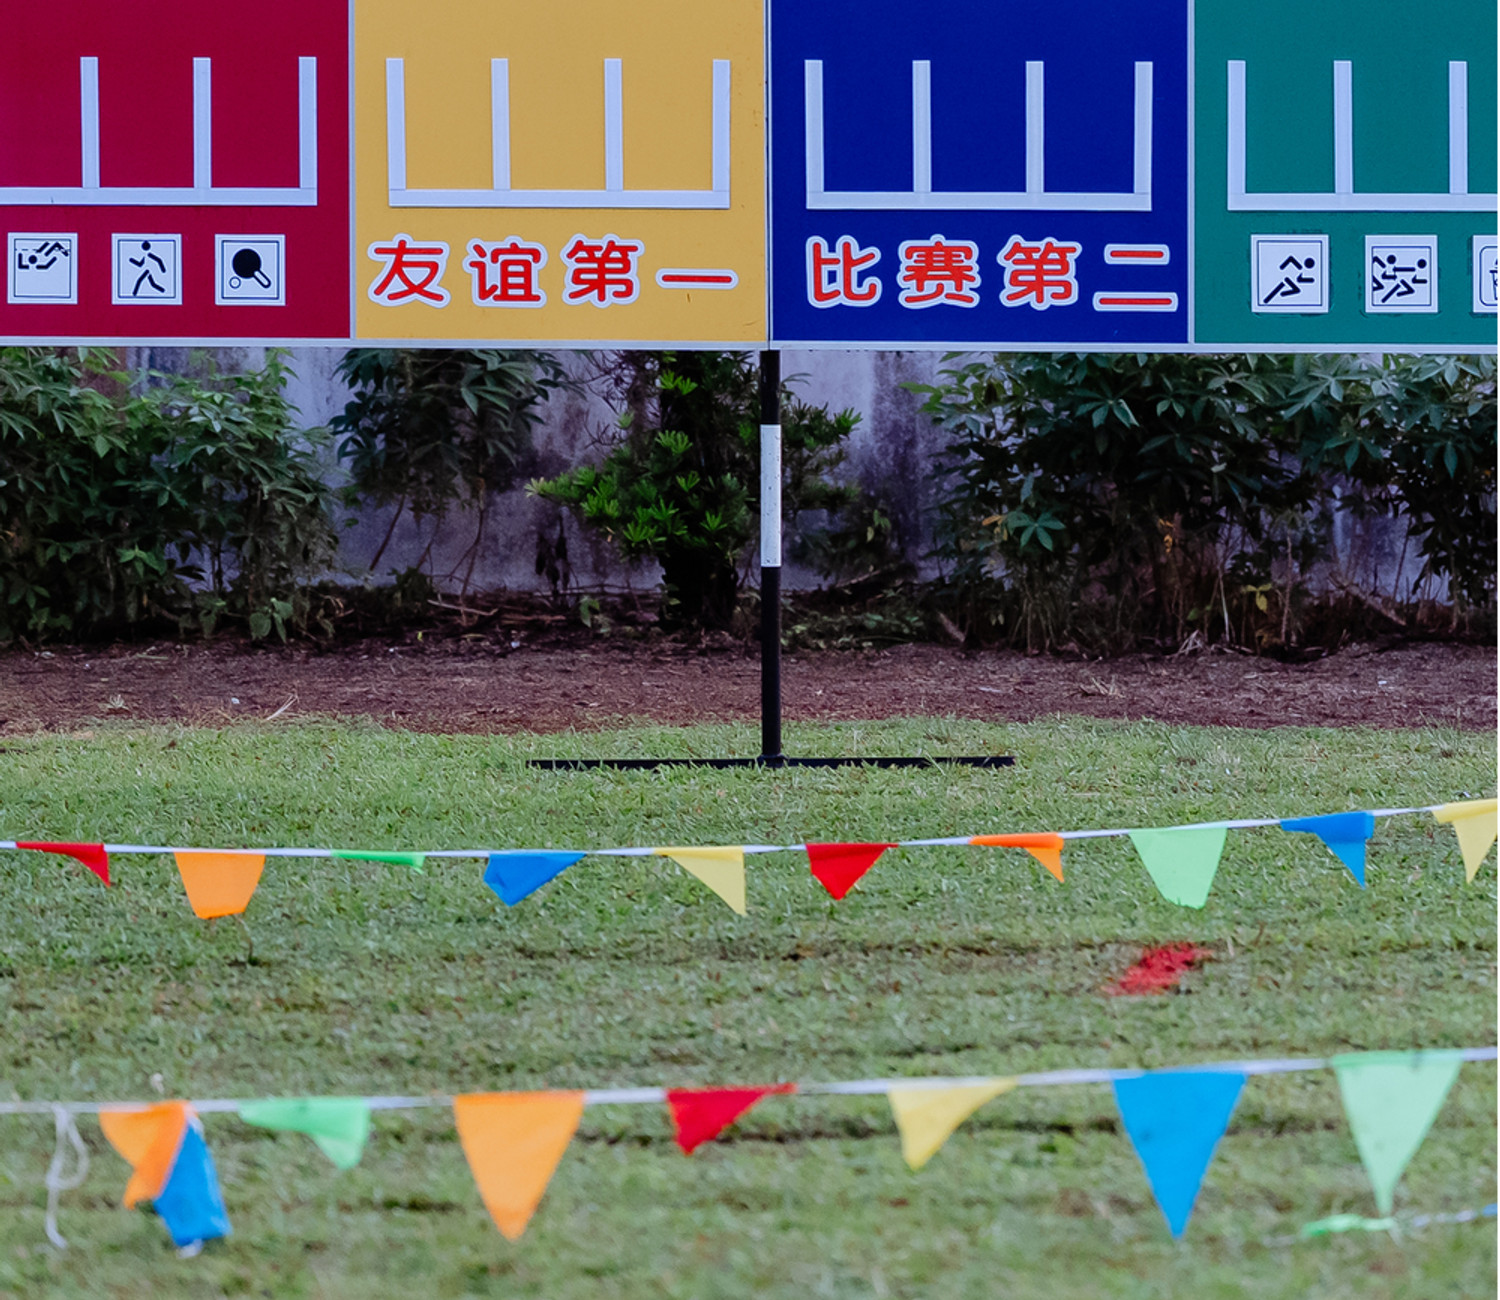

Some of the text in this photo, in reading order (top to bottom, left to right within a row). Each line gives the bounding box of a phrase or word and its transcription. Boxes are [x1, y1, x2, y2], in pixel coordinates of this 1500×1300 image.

[371, 236, 736, 306] 友谊第一
[810, 237, 1175, 309] 比赛第二
